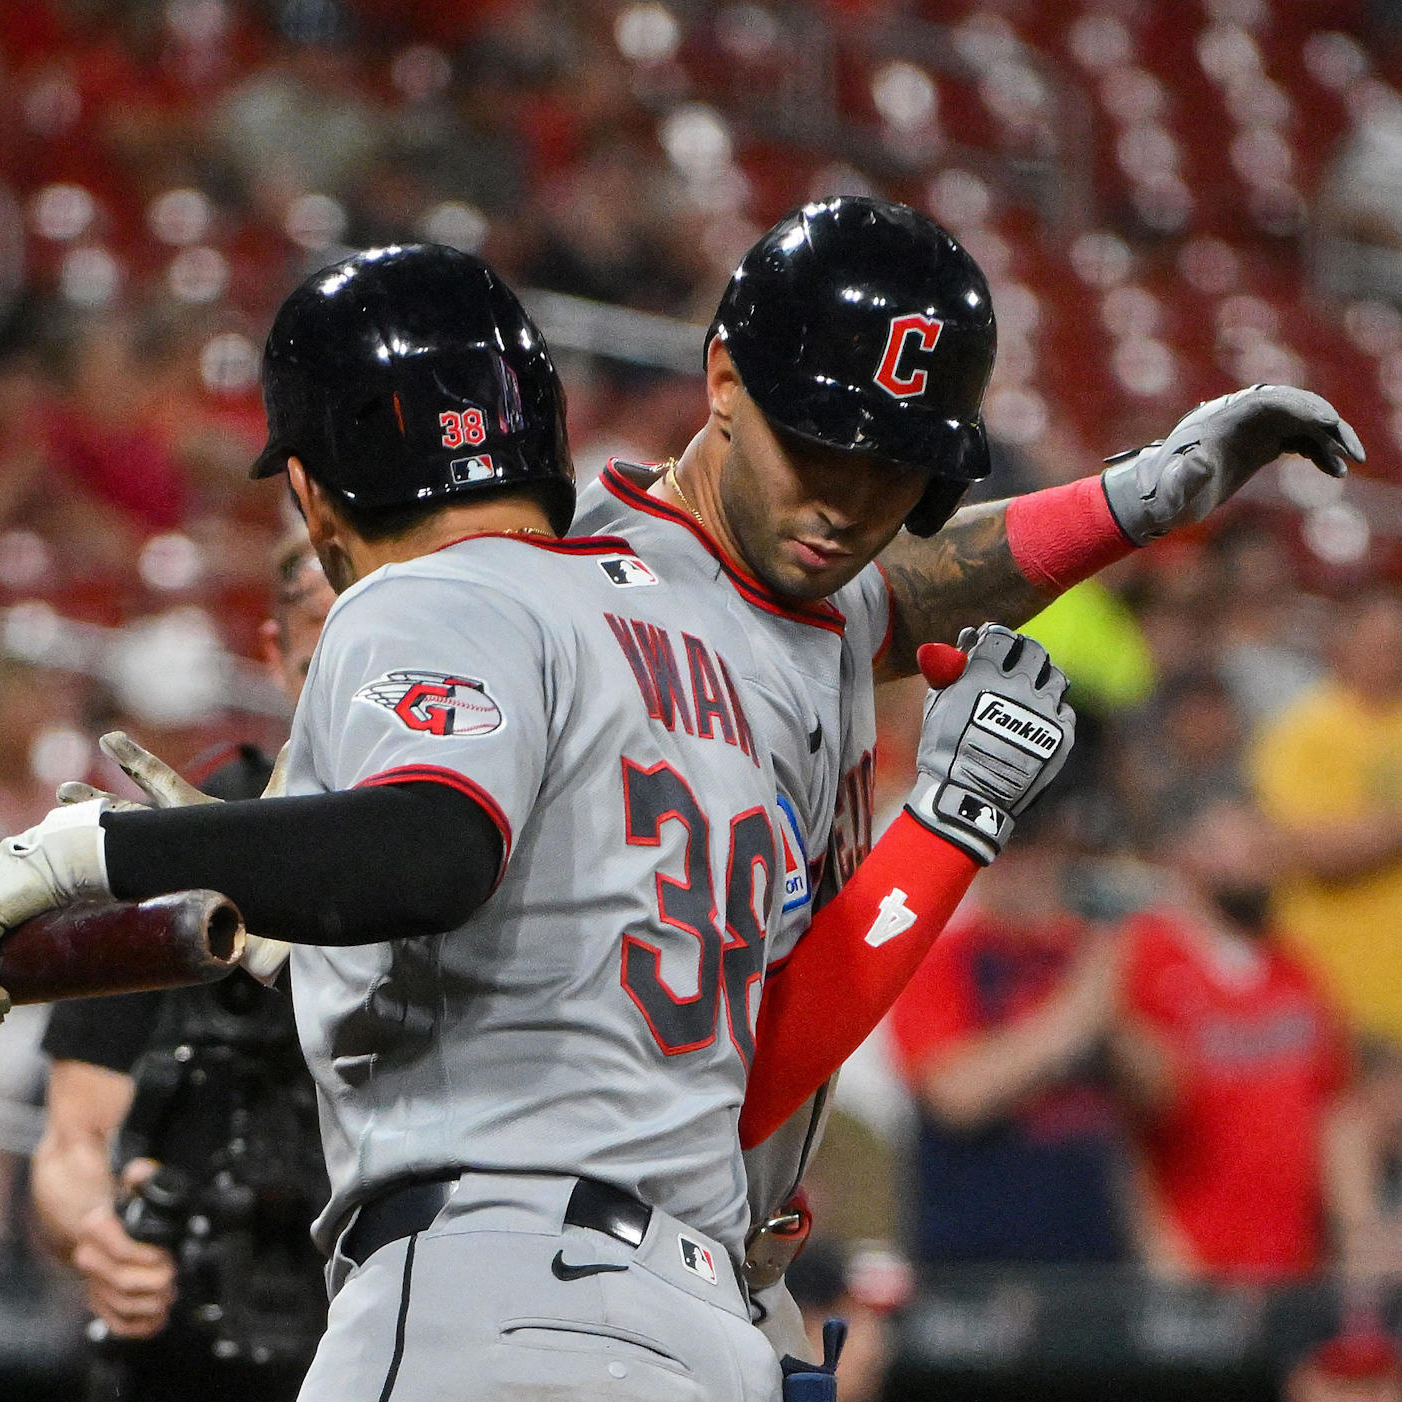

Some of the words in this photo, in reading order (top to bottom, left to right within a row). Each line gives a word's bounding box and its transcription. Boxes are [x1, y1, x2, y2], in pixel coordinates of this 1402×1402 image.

[873, 313, 944, 399] C
[439, 407, 486, 449] 38
[977, 700, 1057, 751] Franklin
[620, 754, 776, 1075] 38
[864, 887, 918, 948] 4
